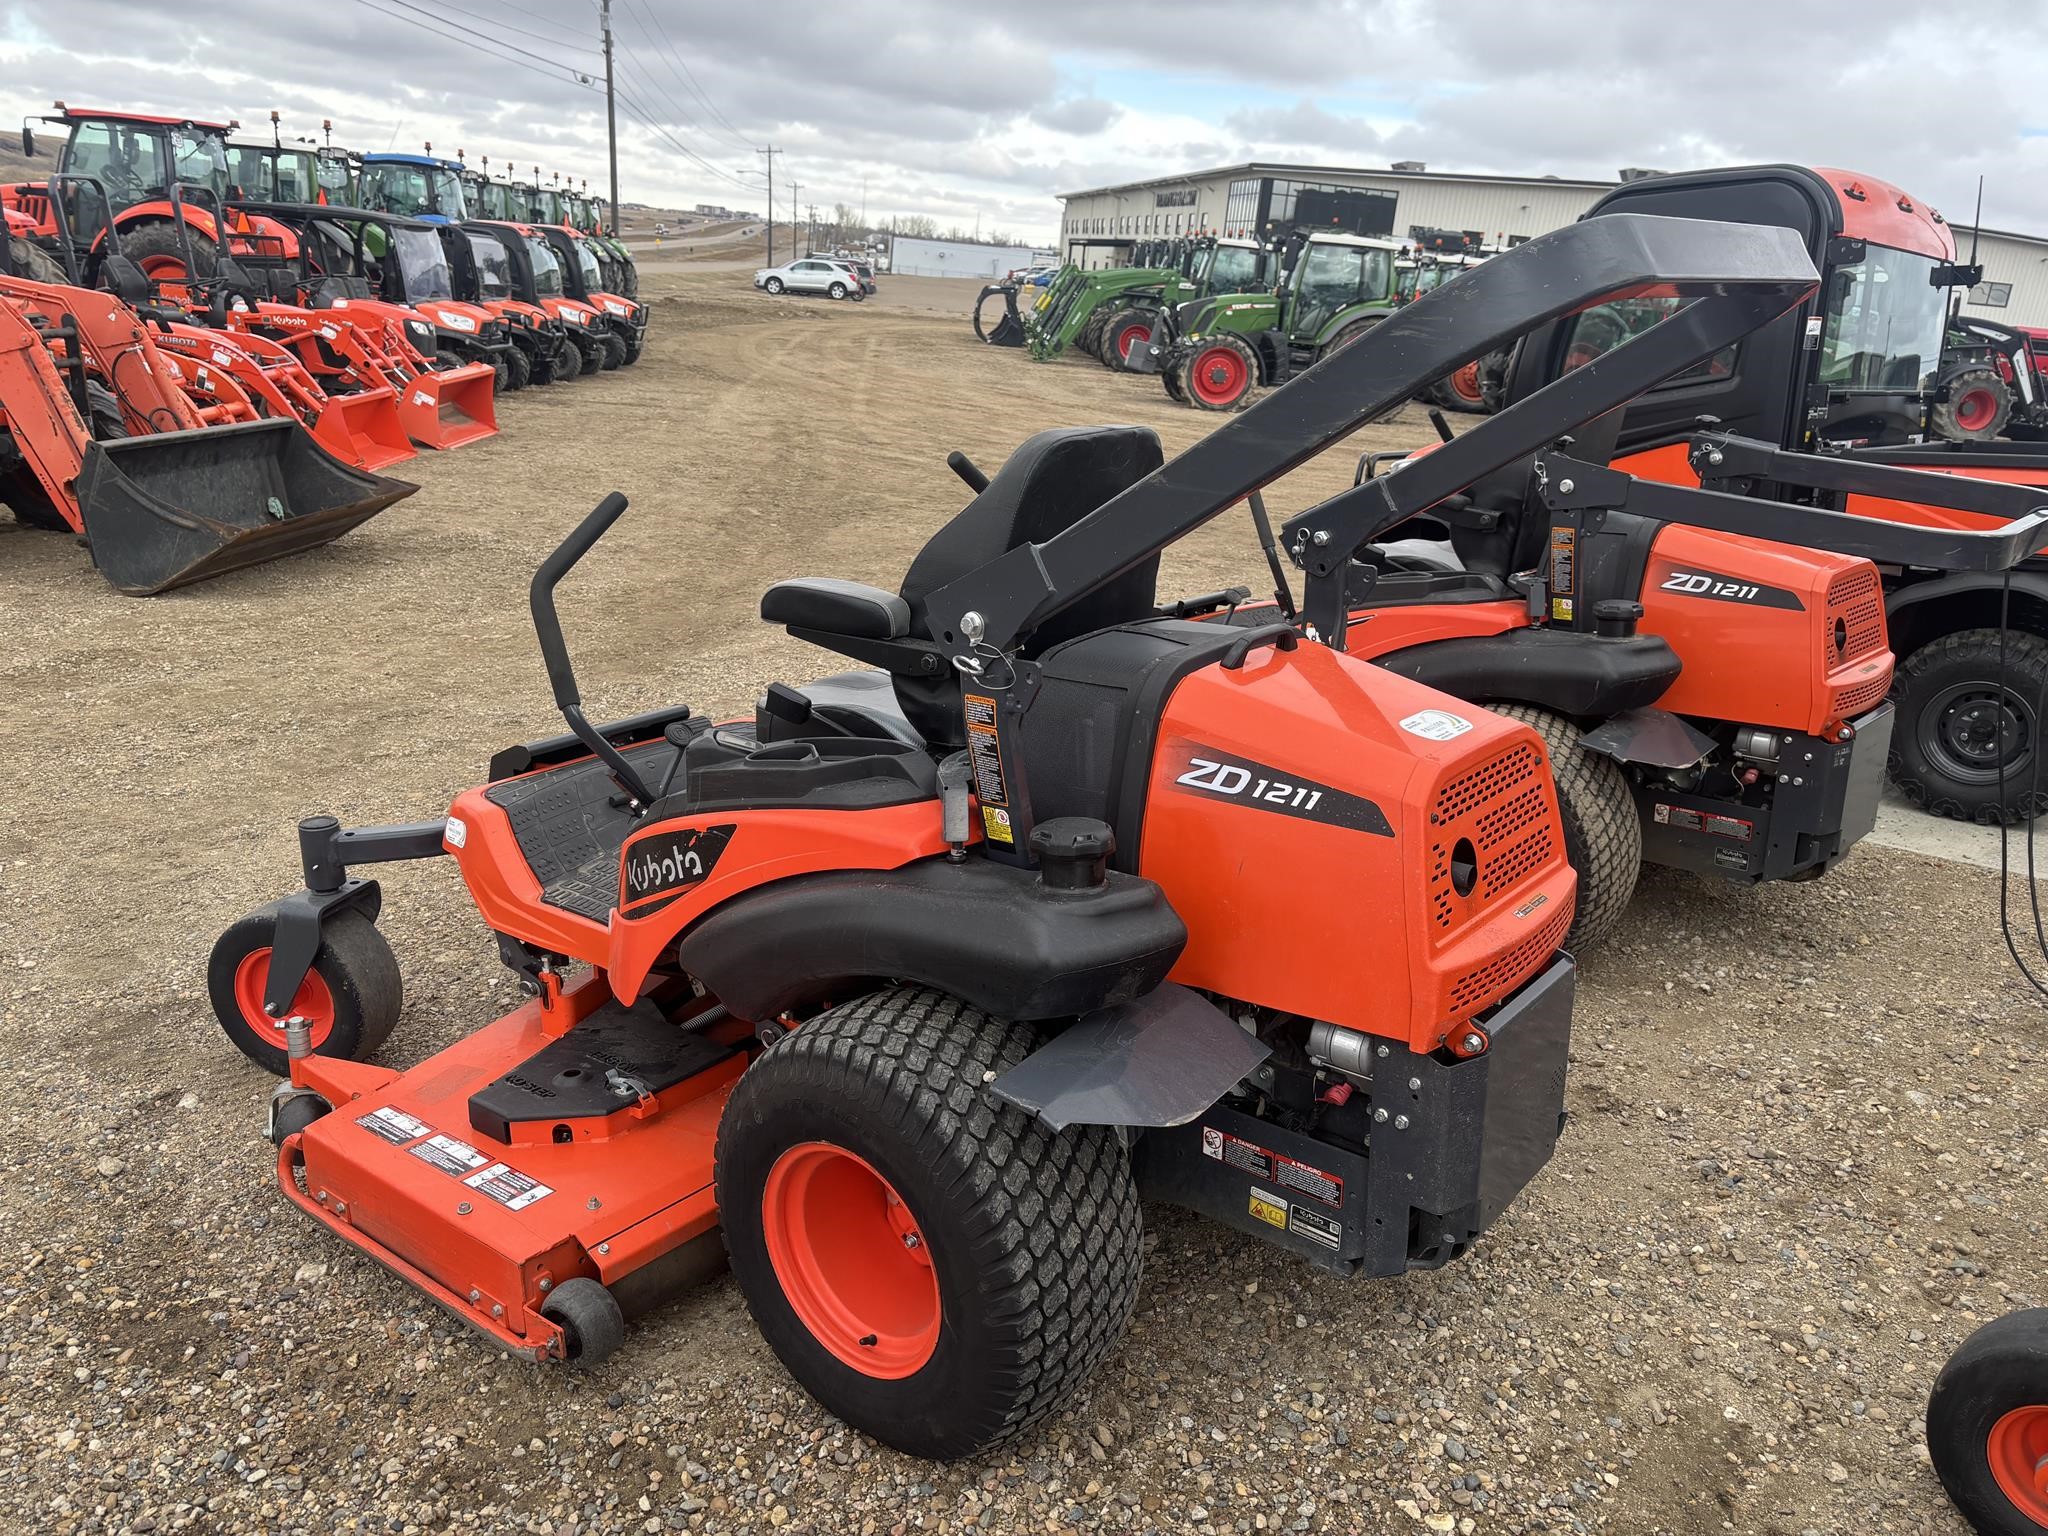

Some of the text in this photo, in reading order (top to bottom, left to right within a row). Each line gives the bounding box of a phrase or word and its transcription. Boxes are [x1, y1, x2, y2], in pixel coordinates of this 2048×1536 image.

[272, 315, 307, 326] Kubota
[157, 335, 198, 347] KUBOTA
[1661, 572, 1760, 599] ZD 1211
[1175, 757, 1323, 811] ZD 1211
[627, 845, 703, 892] Kubota
[1237, 1139, 1261, 1153] DANGER
[1296, 1161, 1322, 1176] PELIGRO
